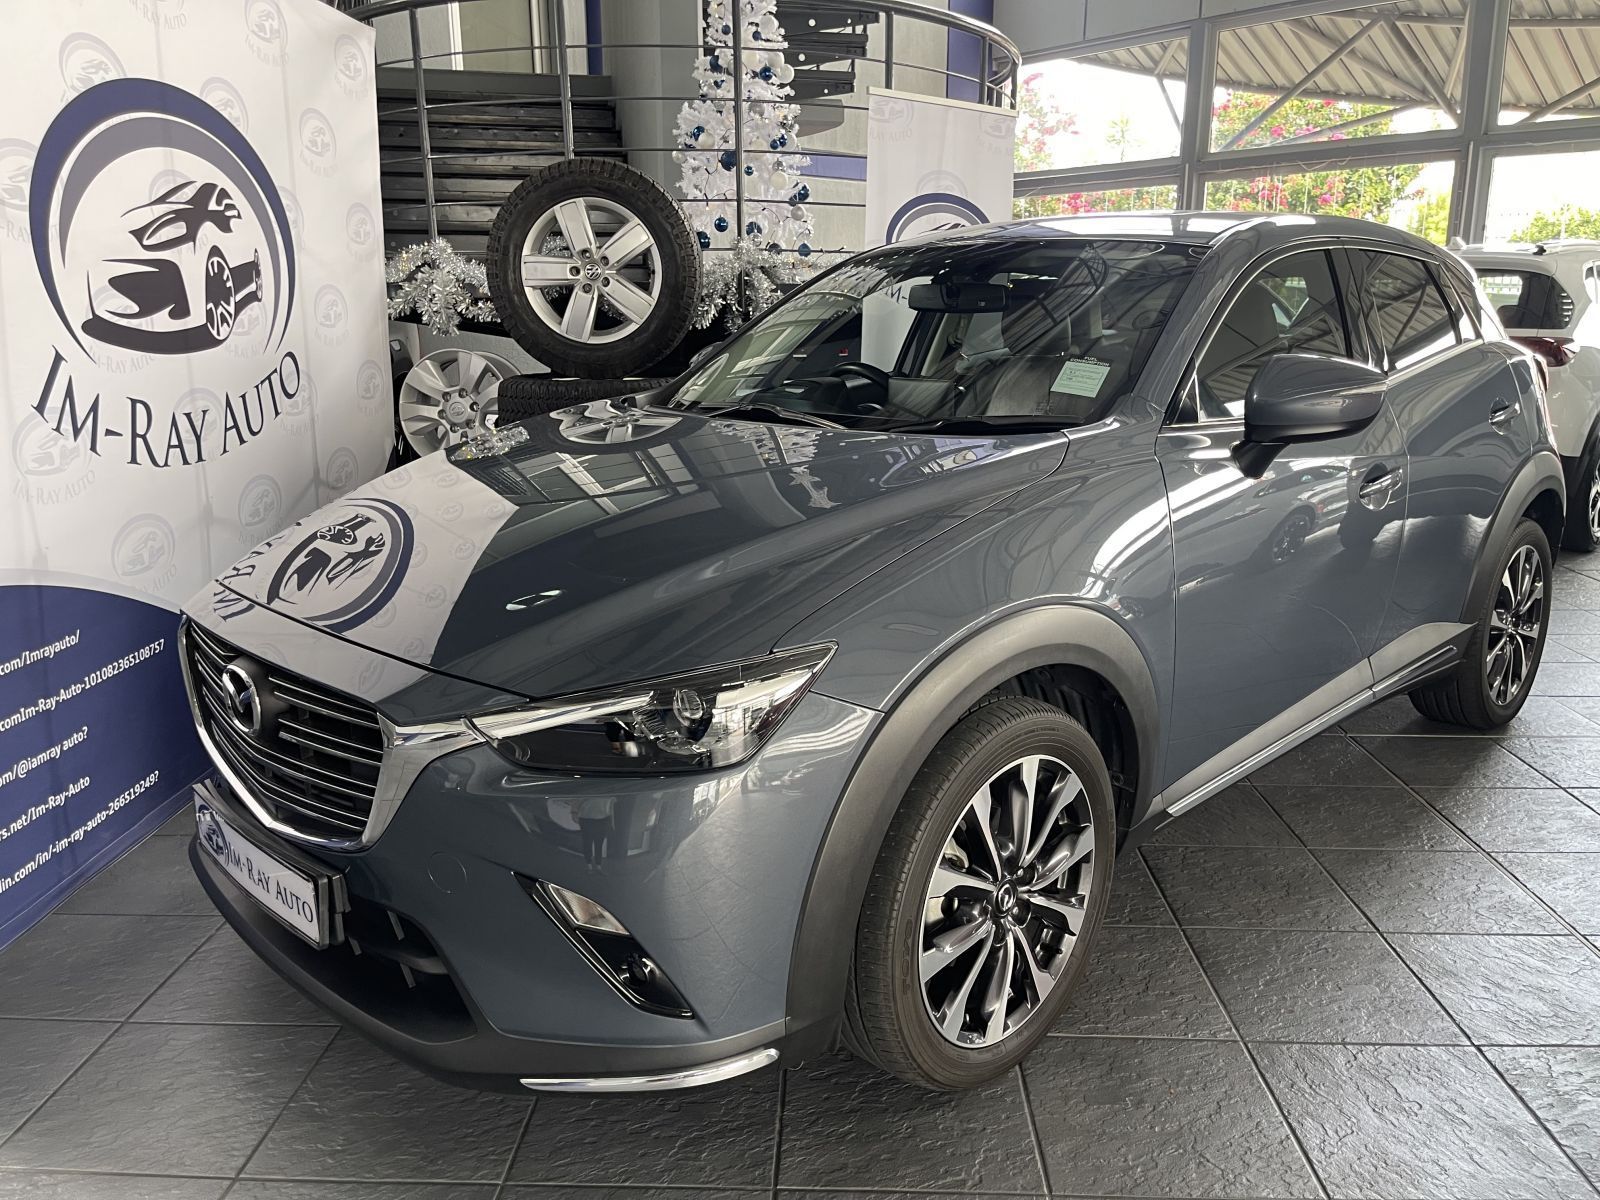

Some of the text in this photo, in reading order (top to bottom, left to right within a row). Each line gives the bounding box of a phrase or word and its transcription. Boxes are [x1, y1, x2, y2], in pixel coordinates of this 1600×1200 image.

[219, 351, 300, 457] AUTO
[62, 726, 88, 751] auto?
[275, 879, 314, 923] AUTO
